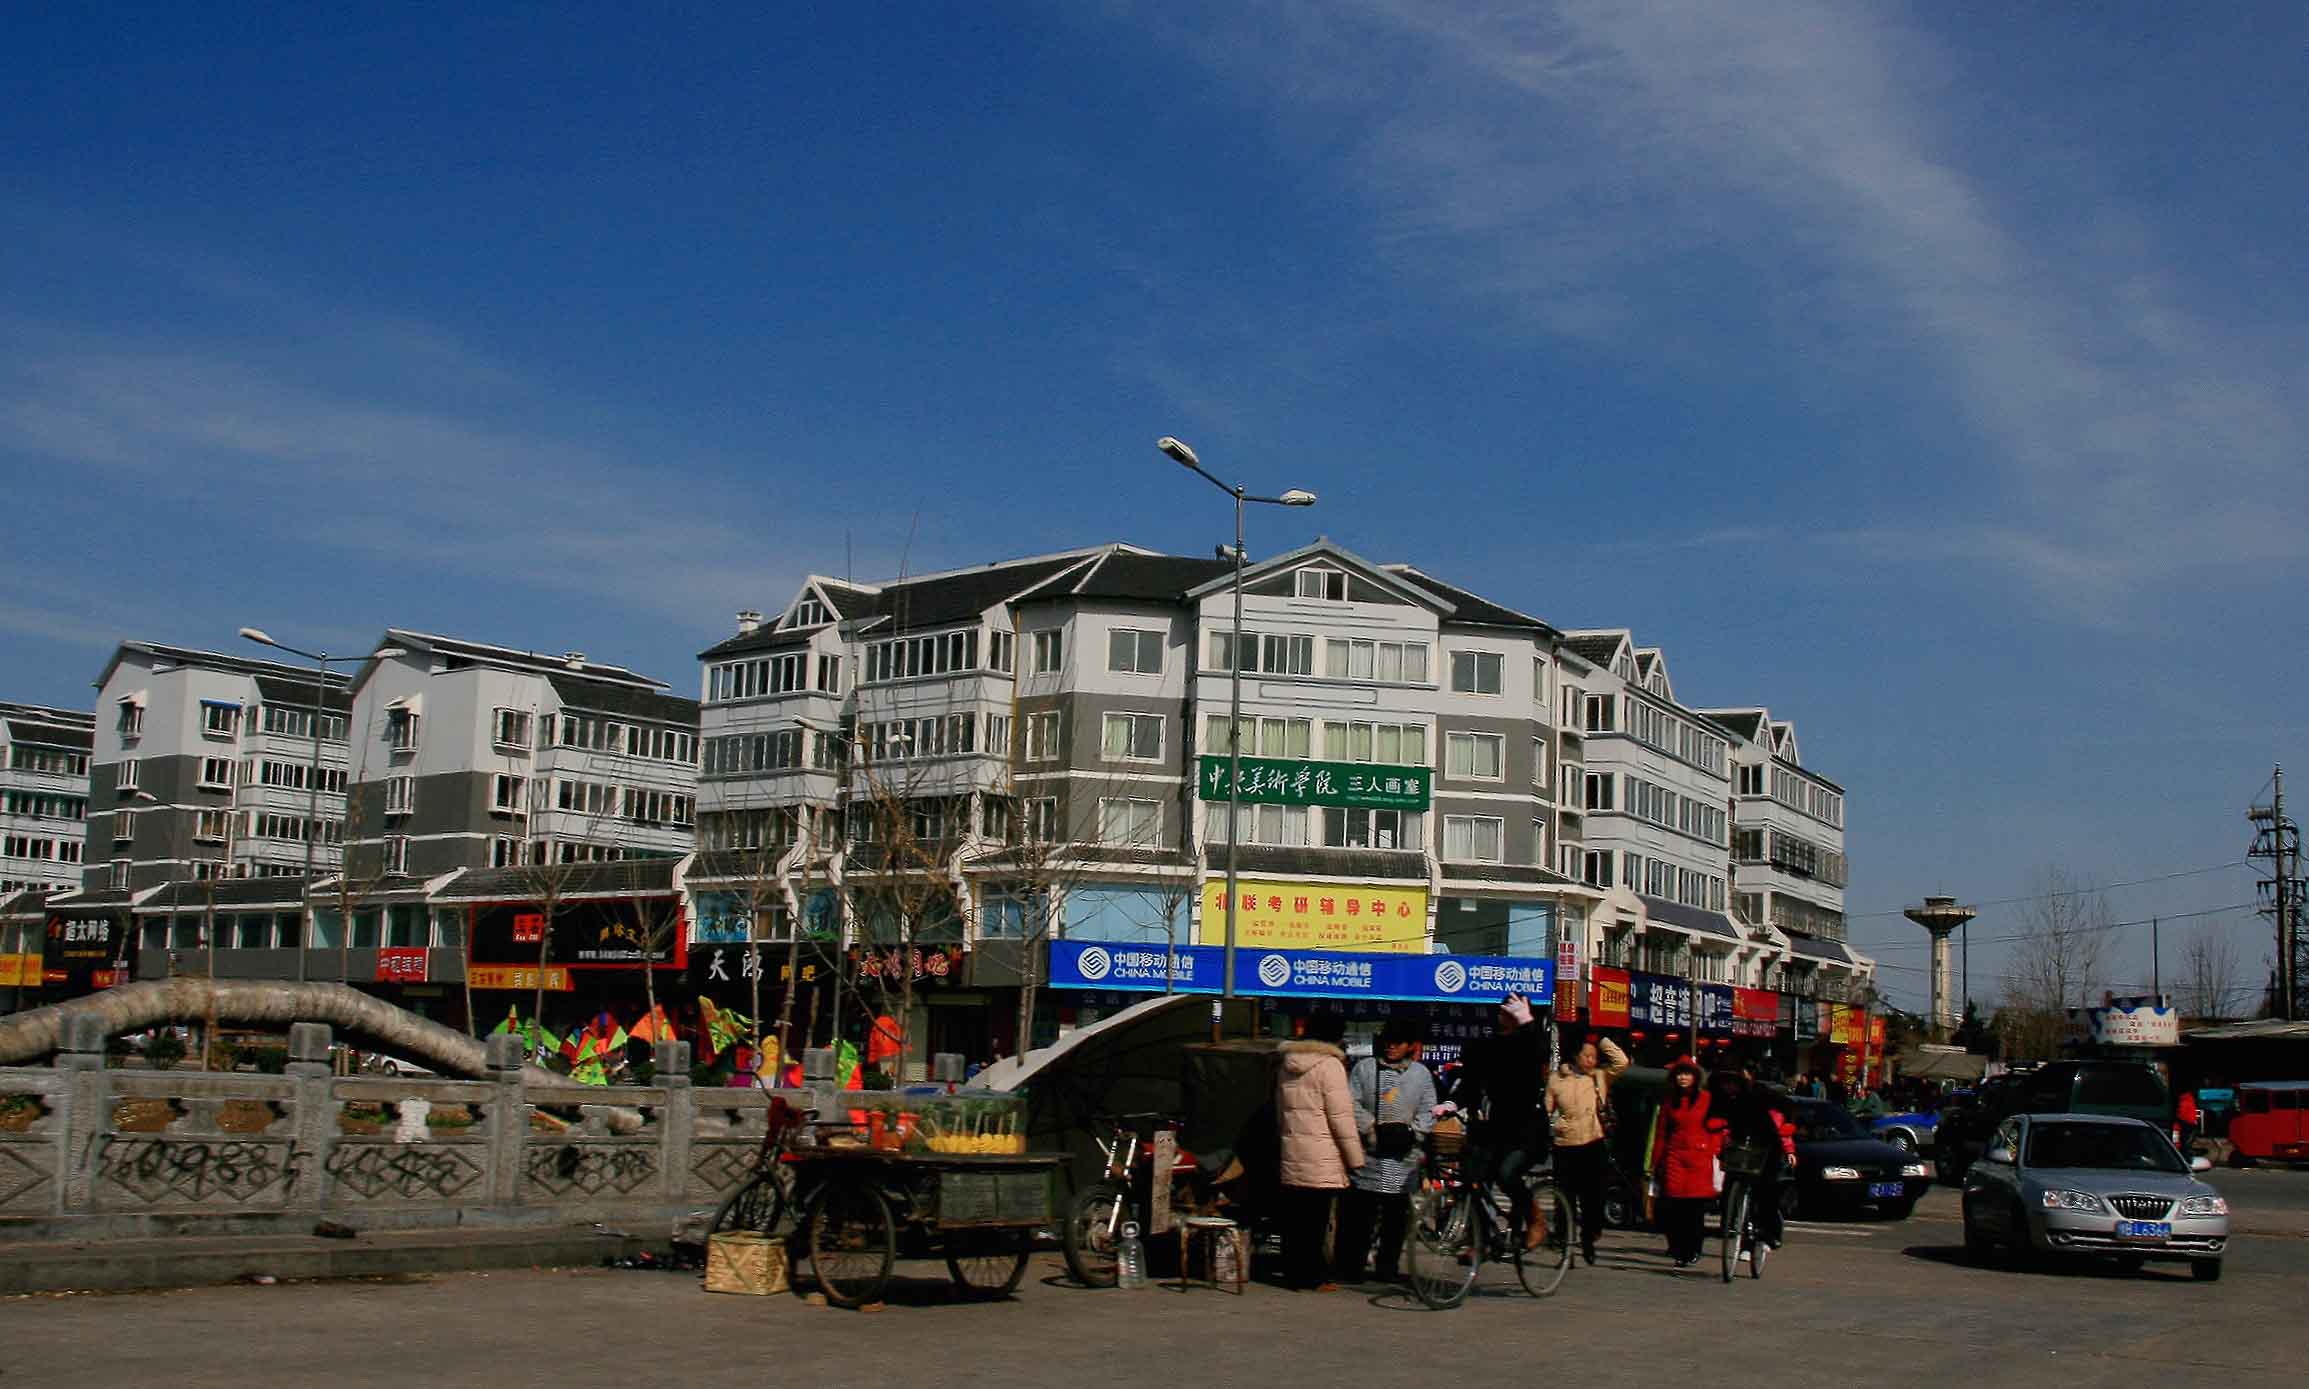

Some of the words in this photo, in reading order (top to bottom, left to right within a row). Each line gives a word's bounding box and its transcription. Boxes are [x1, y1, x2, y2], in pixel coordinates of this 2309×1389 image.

[1347, 775, 1420, 795] 三人画室
[1113, 951, 1194, 970] 中国移动通信
[1294, 959, 1372, 977] 中国移动通信
[1113, 967, 1151, 979] CHINA
[1294, 975, 1329, 986] CHINA
[1331, 977, 1372, 988] MOBILE
[1469, 965, 1545, 983] 中国移动通信
[1469, 981, 1503, 992] CHINA
[1505, 982, 1544, 993] MOBILE
